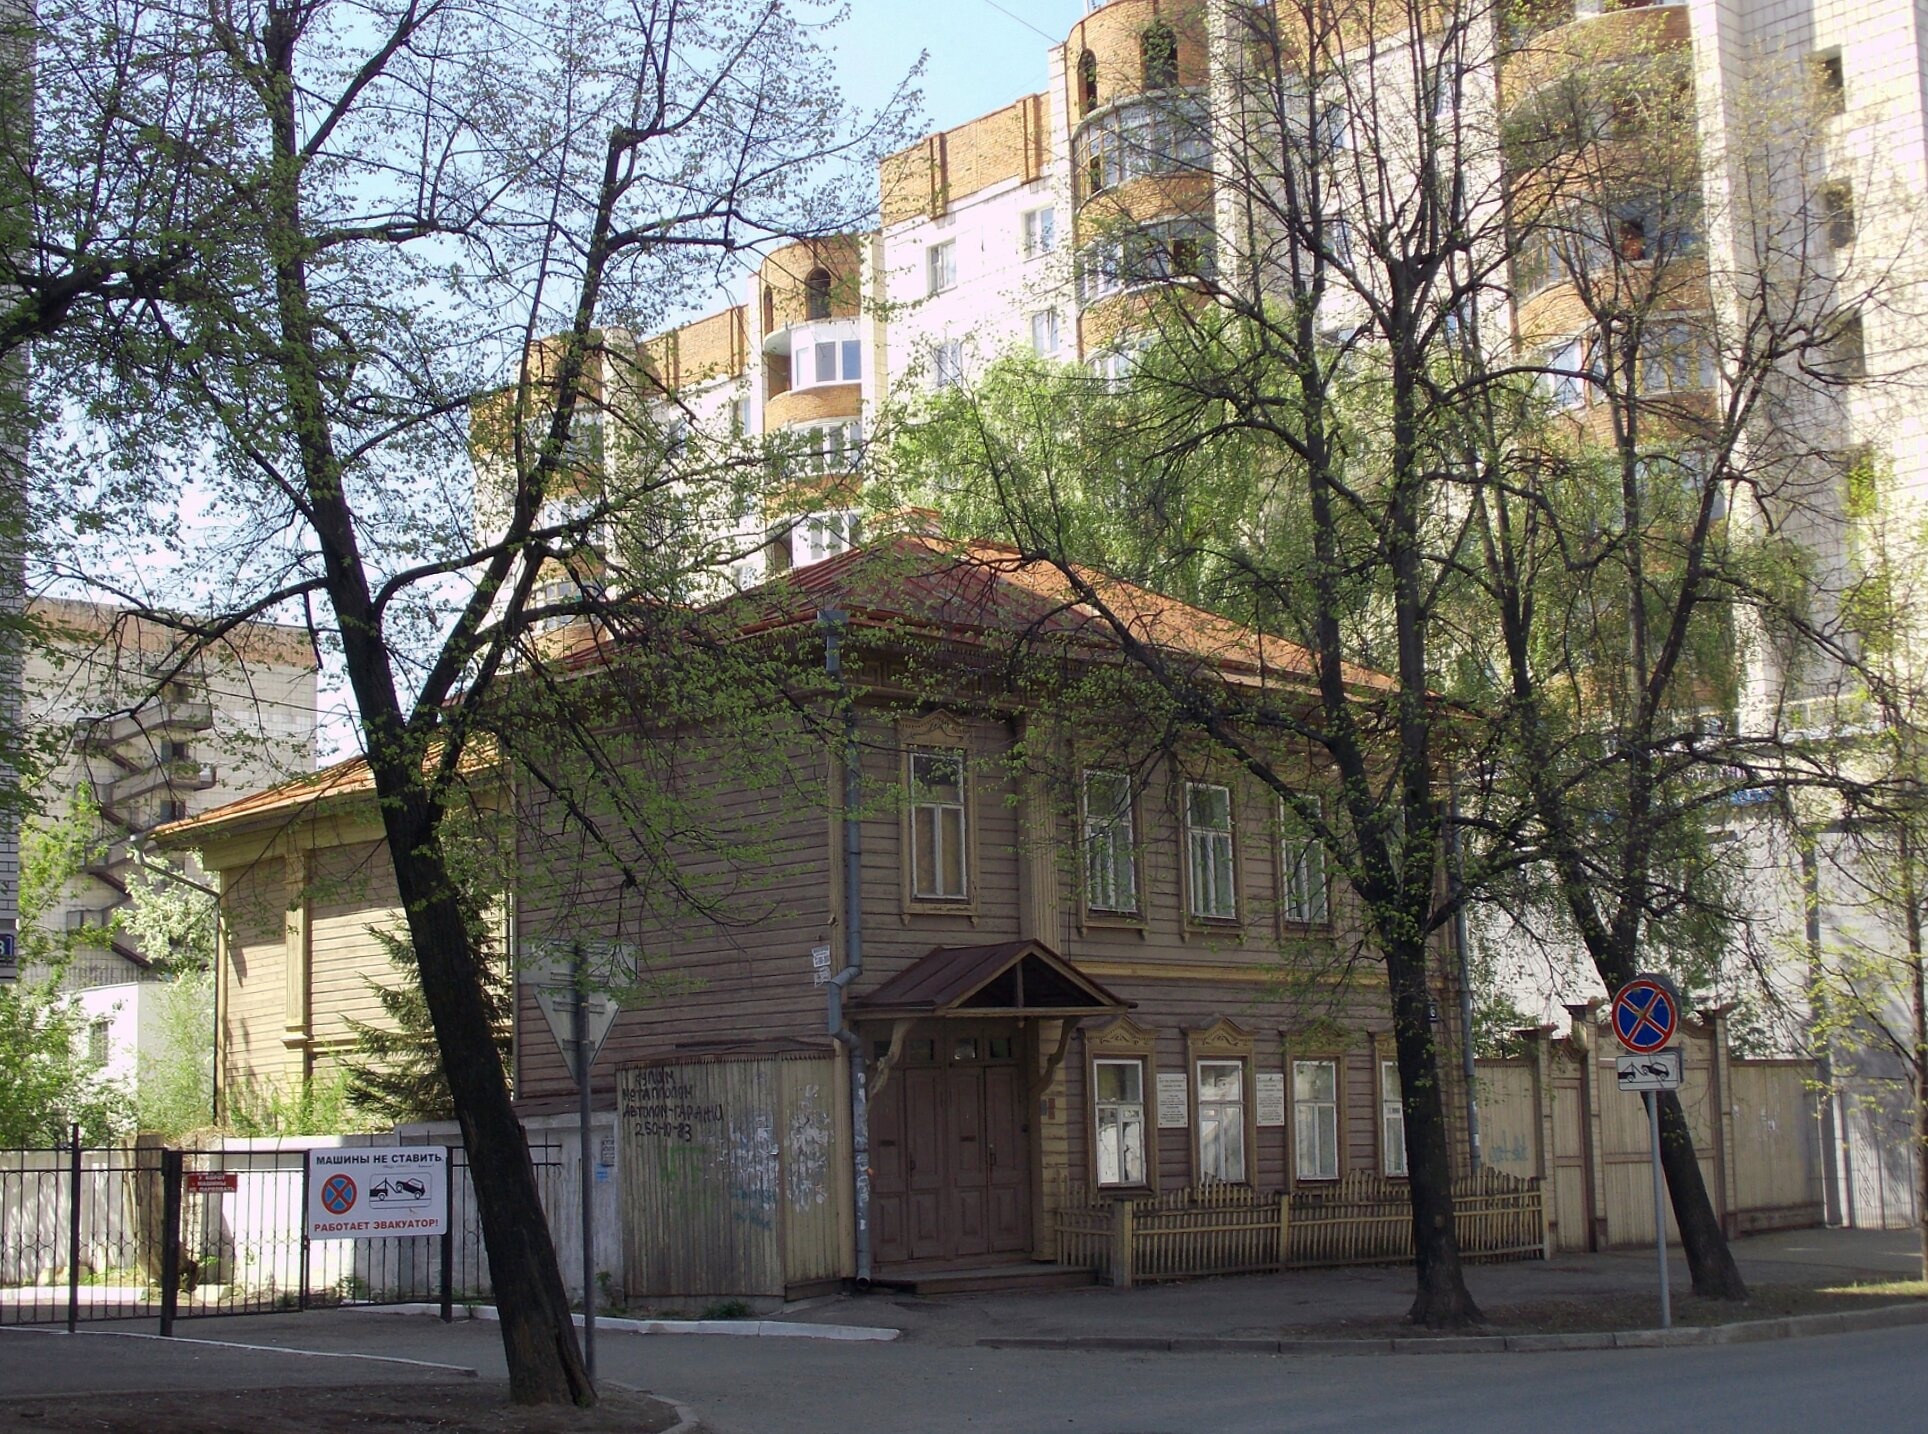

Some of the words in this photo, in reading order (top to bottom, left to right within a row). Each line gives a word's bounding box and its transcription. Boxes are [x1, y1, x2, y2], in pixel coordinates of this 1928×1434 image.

[635, 1121, 692, 1142] 250-10-83
[316, 1155, 369, 1165] МАШИНЫ
[373, 1154, 388, 1164] НЕ
[391, 1153, 442, 1163] СТАВИТЬ
[314, 1222, 370, 1232] РАБОТАЕТ
[373, 1219, 439, 1230] ЭВАКУАТОР!
